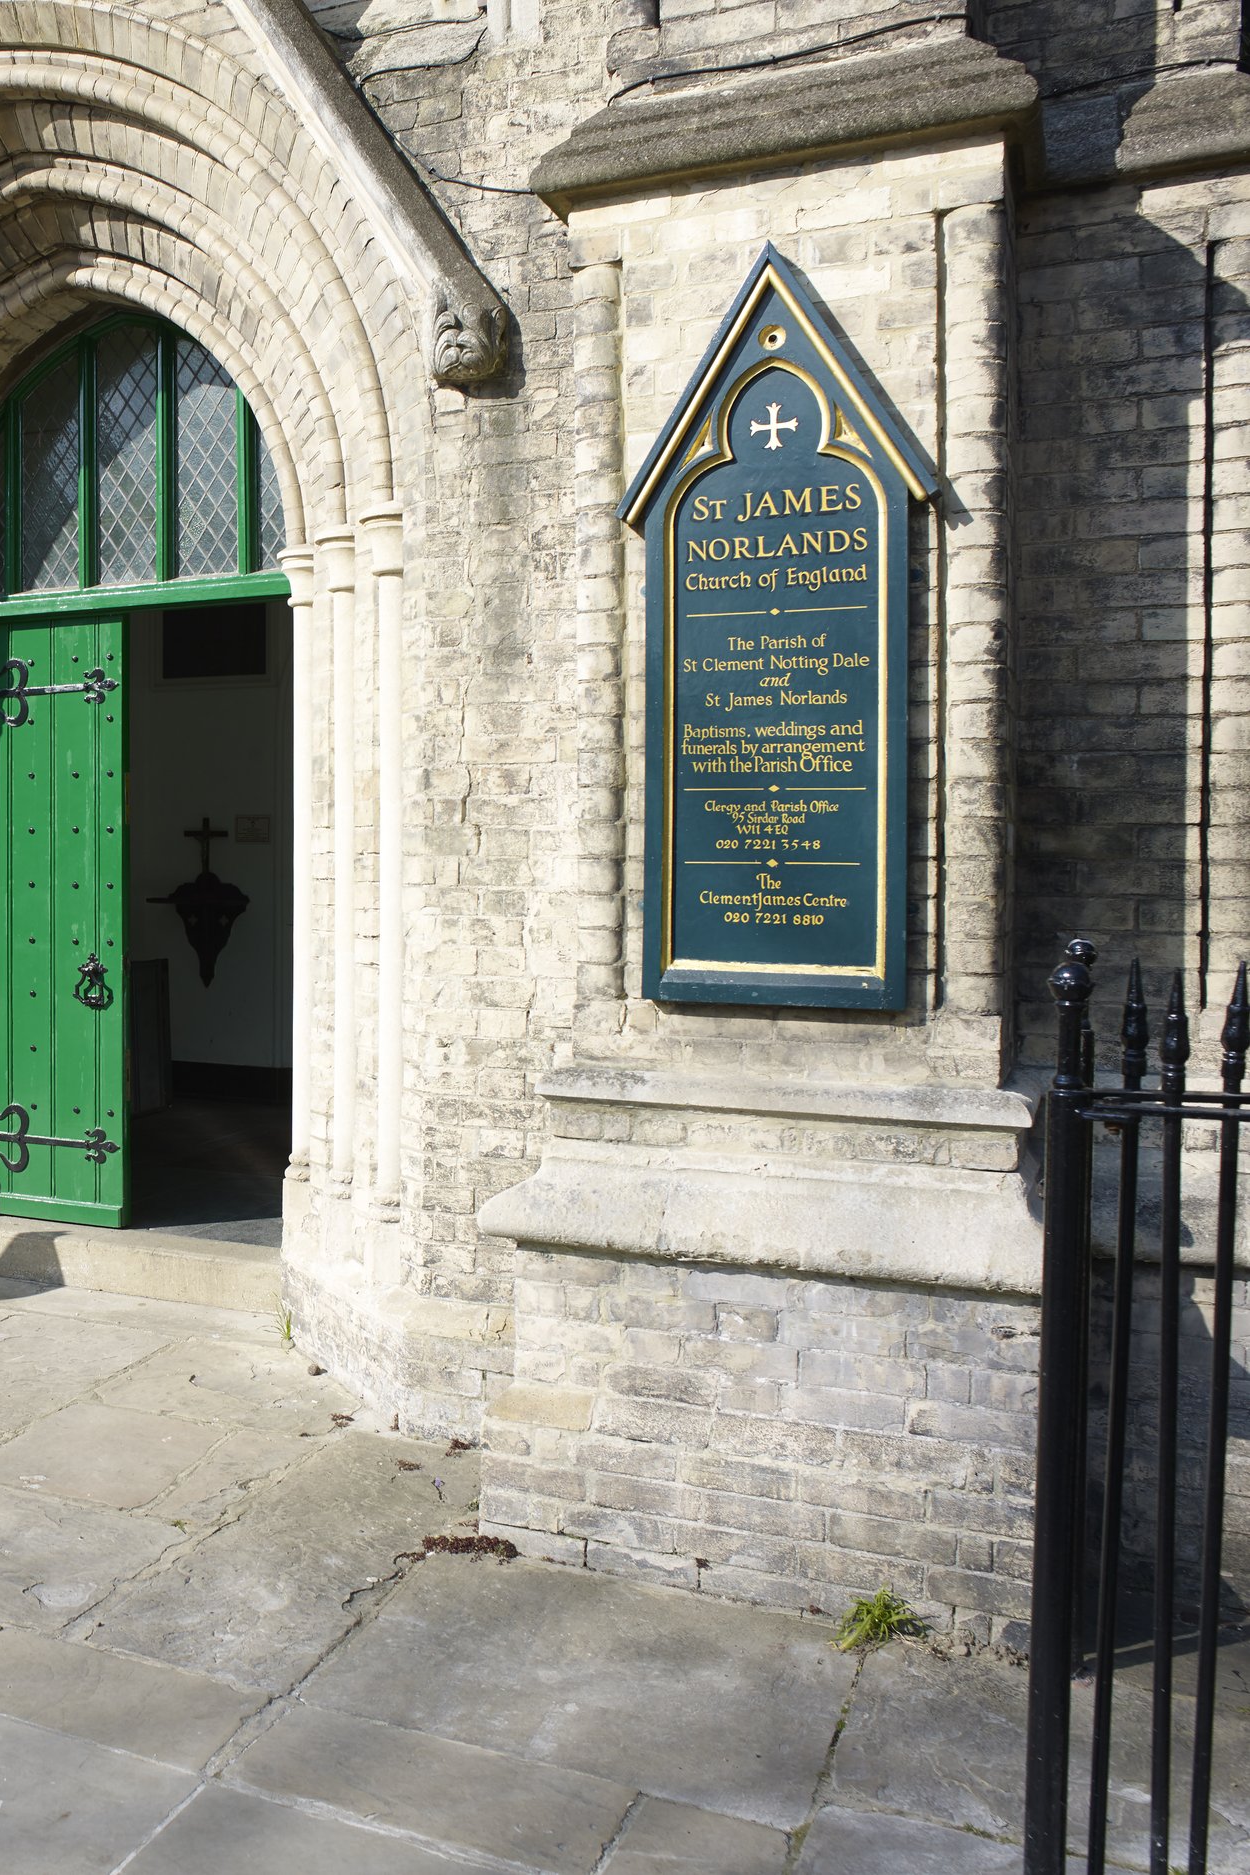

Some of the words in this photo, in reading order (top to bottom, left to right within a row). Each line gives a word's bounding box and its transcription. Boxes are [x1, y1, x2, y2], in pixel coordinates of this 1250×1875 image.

[737, 483, 862, 522] JAMES
[687, 527, 868, 562] NORLANDS
[685, 572, 751, 591] Church
[758, 568, 779, 592] of
[786, 564, 867, 592] England
[727, 637, 755, 651] The
[760, 635, 807, 650] Parish
[811, 634, 827, 647] of
[683, 659, 697, 672] St
[702, 657, 764, 671] Clement
[770, 655, 829, 675] Notting
[832, 653, 870, 667] Dale
[759, 673, 791, 687] and
[705, 693, 721, 707] St
[725, 693, 773, 711] James
[780, 690, 848, 705] Norlands
[755, 722, 825, 739] weddings
[830, 720, 863, 736] and
[681, 740, 737, 755] funerals
[740, 741, 757, 758] by
[761, 741, 866, 759] arrangement
[692, 758, 727, 773] with
[730, 757, 752, 772] the
[754, 757, 798, 772] Parish
[800, 754, 853, 772] Office
[704, 801, 740, 815] Clergy
[744, 799, 766, 812] and
[770, 799, 807, 812] Parish
[809, 801, 839, 813] Office
[732, 812, 745, 823] 95
[747, 813, 779, 823] Sirdar
[781, 813, 806, 823] Road
[763, 825, 789, 835] 4EQ
[716, 840, 739, 849] 020
[744, 839, 776, 850] 7221
[782, 840, 821, 850] 3548
[756, 873, 782, 889] The
[699, 891, 801, 911] ClementJames
[803, 893, 847, 908] Centre
[724, 912, 750, 923] 020
[755, 912, 787, 924] 7221
[792, 915, 824, 925] 8810
